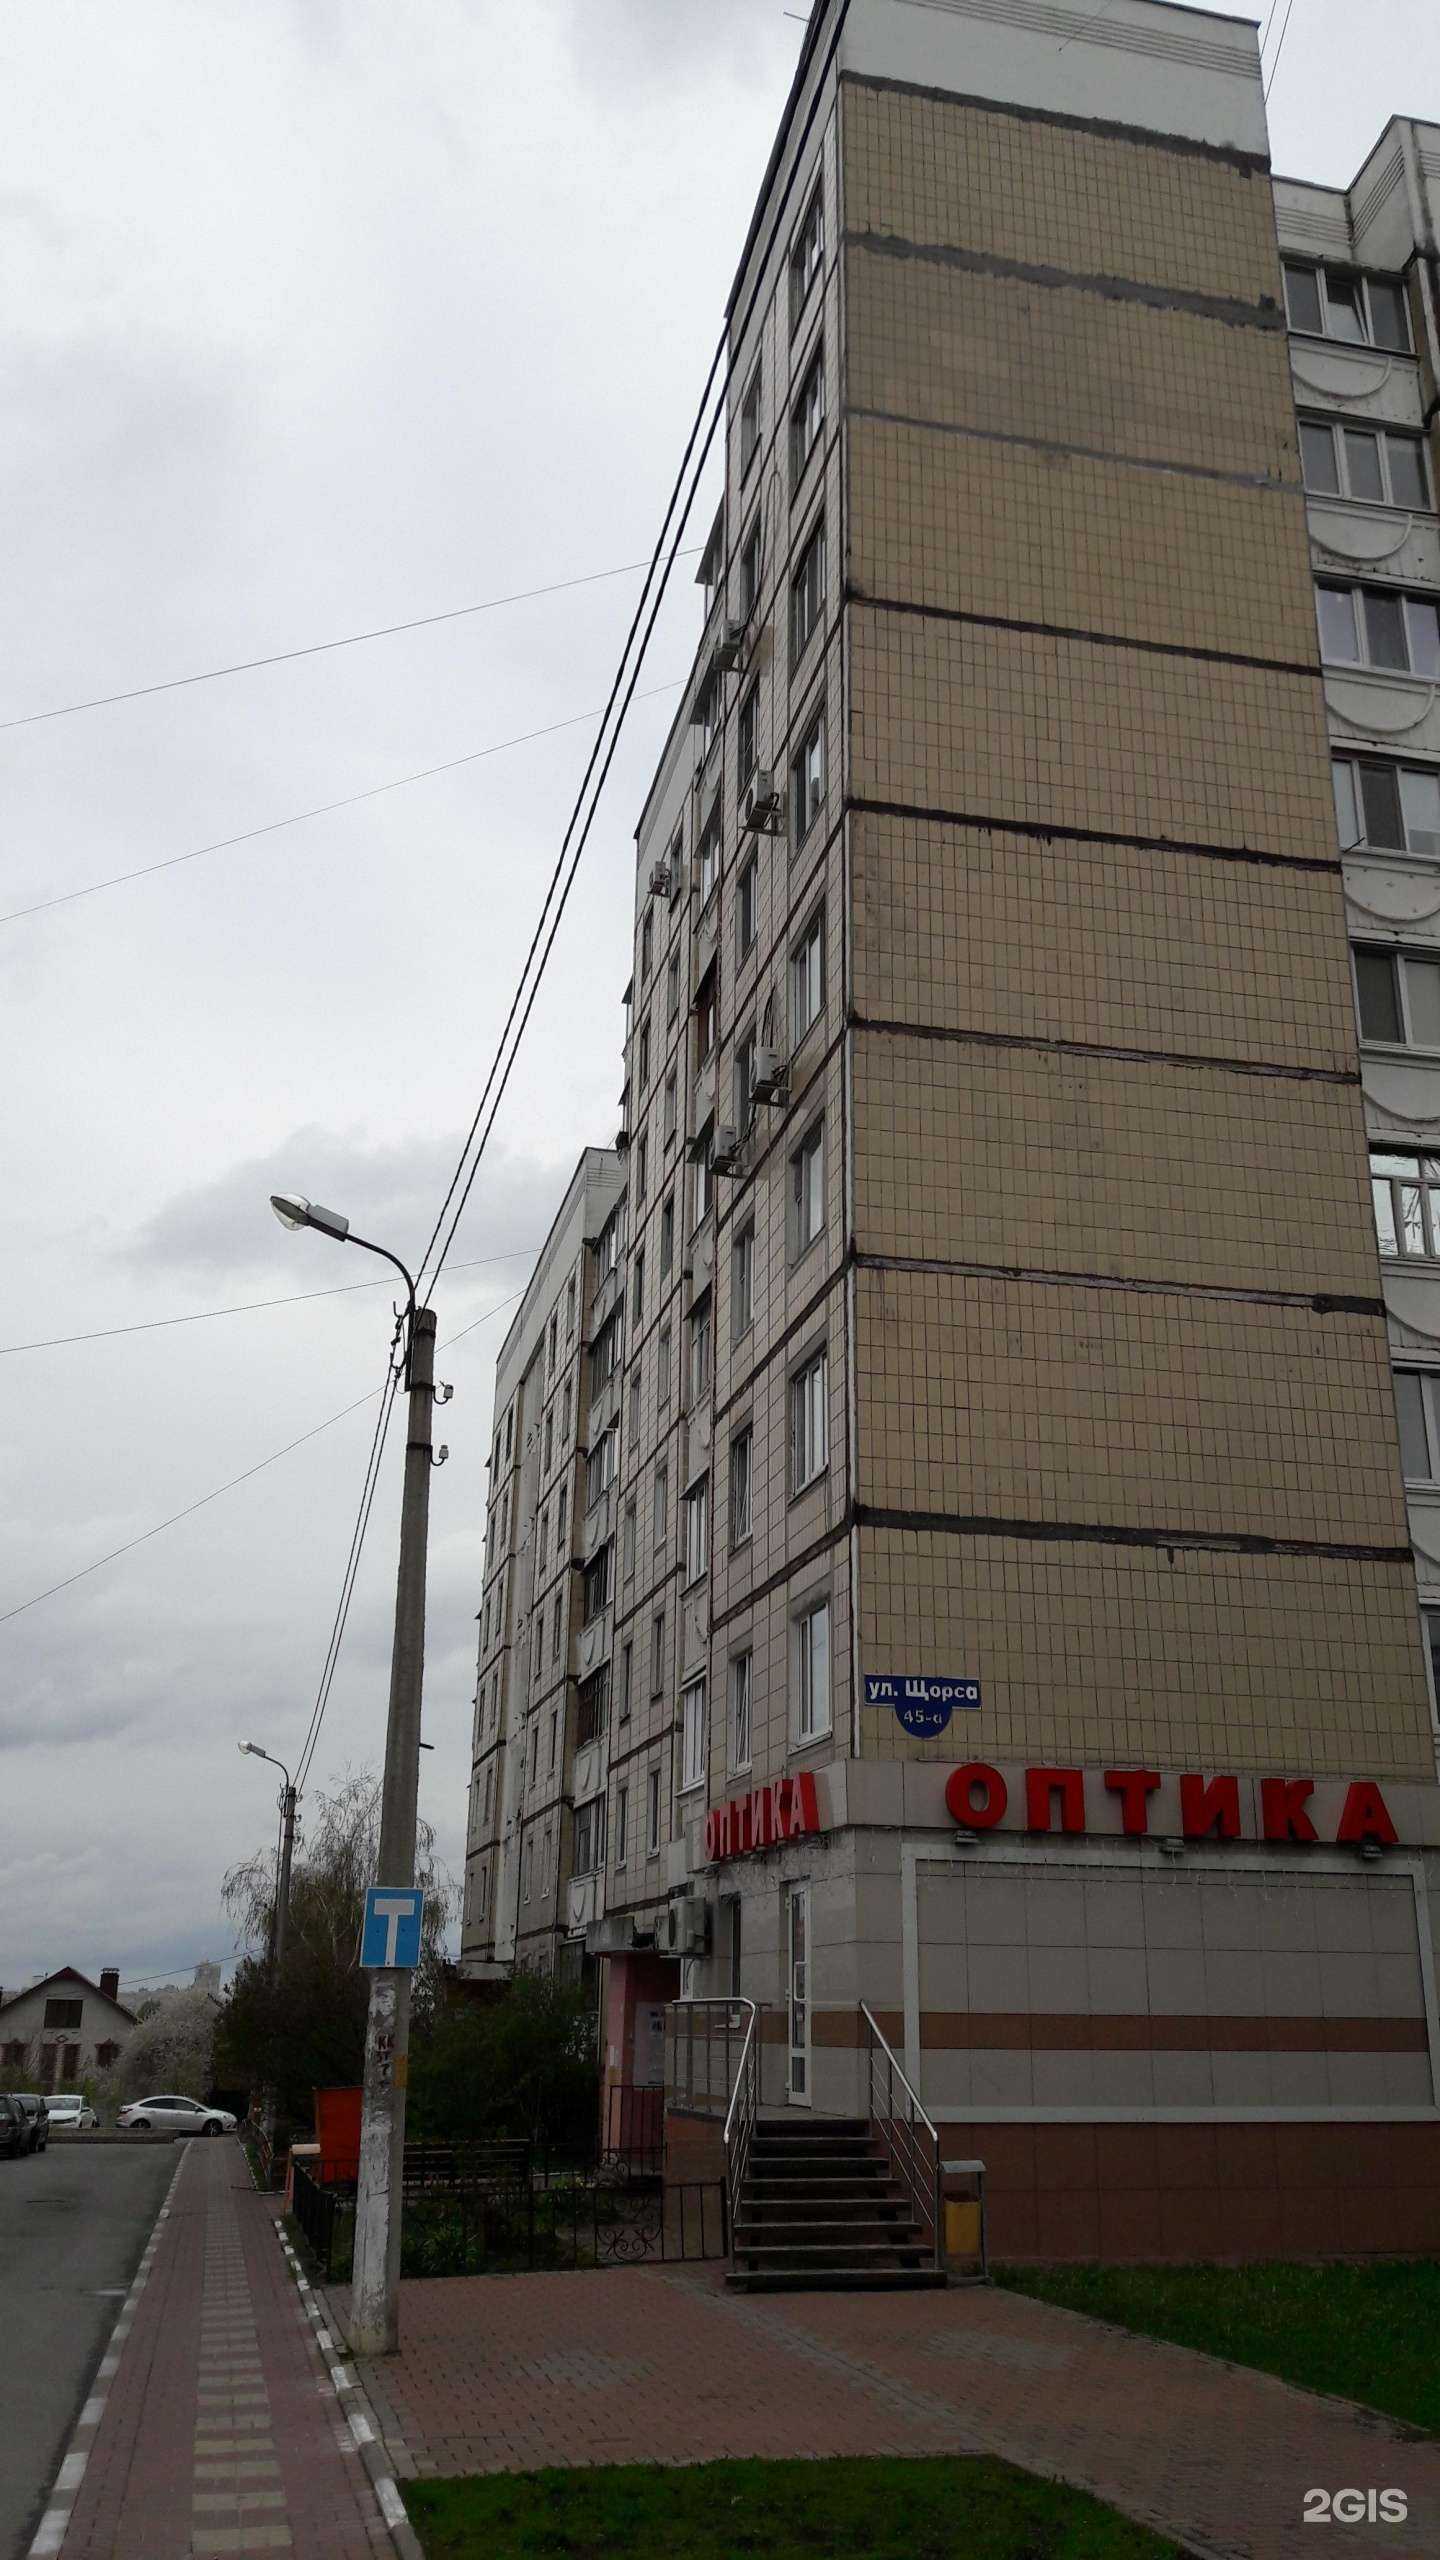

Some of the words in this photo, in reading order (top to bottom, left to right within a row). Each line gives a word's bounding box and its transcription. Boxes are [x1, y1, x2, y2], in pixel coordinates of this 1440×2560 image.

[868, 1681, 899, 1700] ул.
[905, 1679, 978, 1702] Щорса
[705, 1772, 820, 1862] ОПТИКА
[945, 1763, 1400, 1844] ОПТИКА
